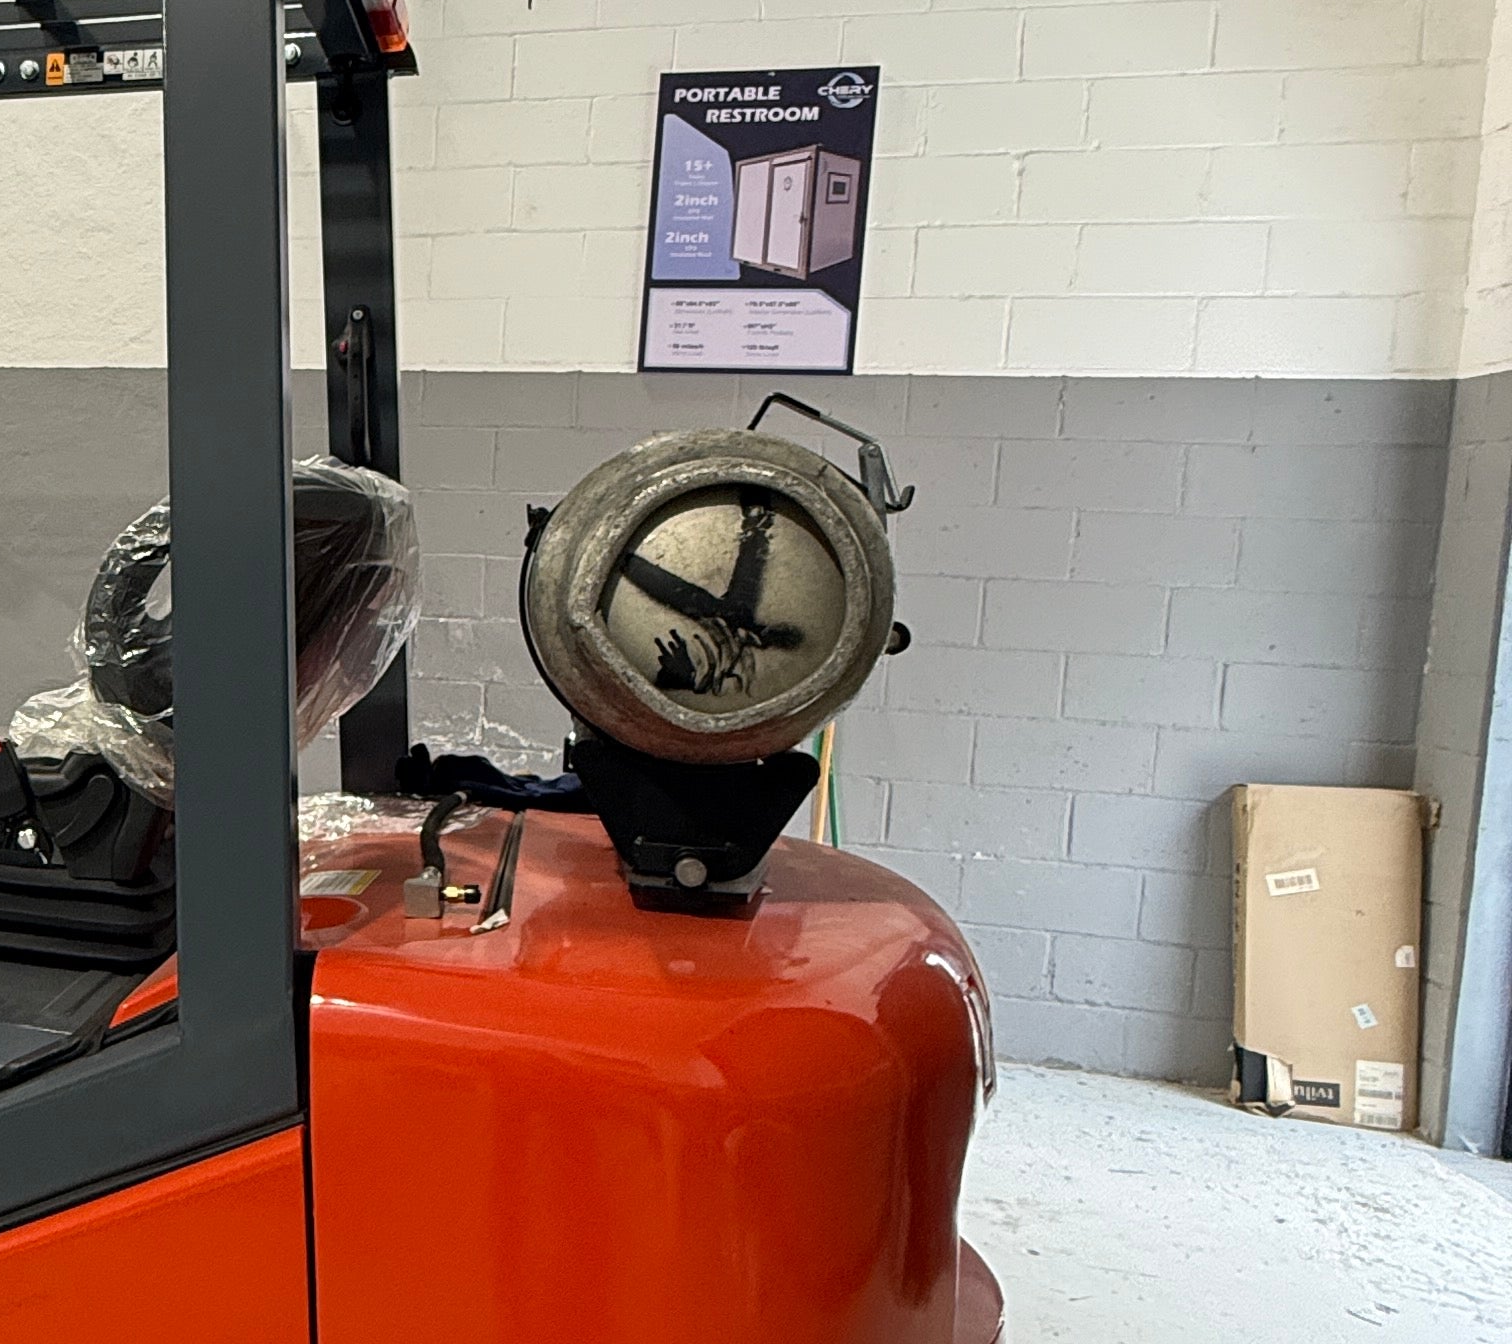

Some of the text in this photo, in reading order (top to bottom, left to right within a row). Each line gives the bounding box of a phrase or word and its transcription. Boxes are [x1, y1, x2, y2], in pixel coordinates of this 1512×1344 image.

[674, 86, 781, 102] PORTABLE
[817, 83, 874, 97] CHERY
[705, 107, 820, 123] RESTROOM
[685, 159, 713, 172] 15+
[674, 194, 719, 207] 2inch
[665, 231, 709, 244] 2inch
[1293, 1085, 1335, 1102] tvilu
